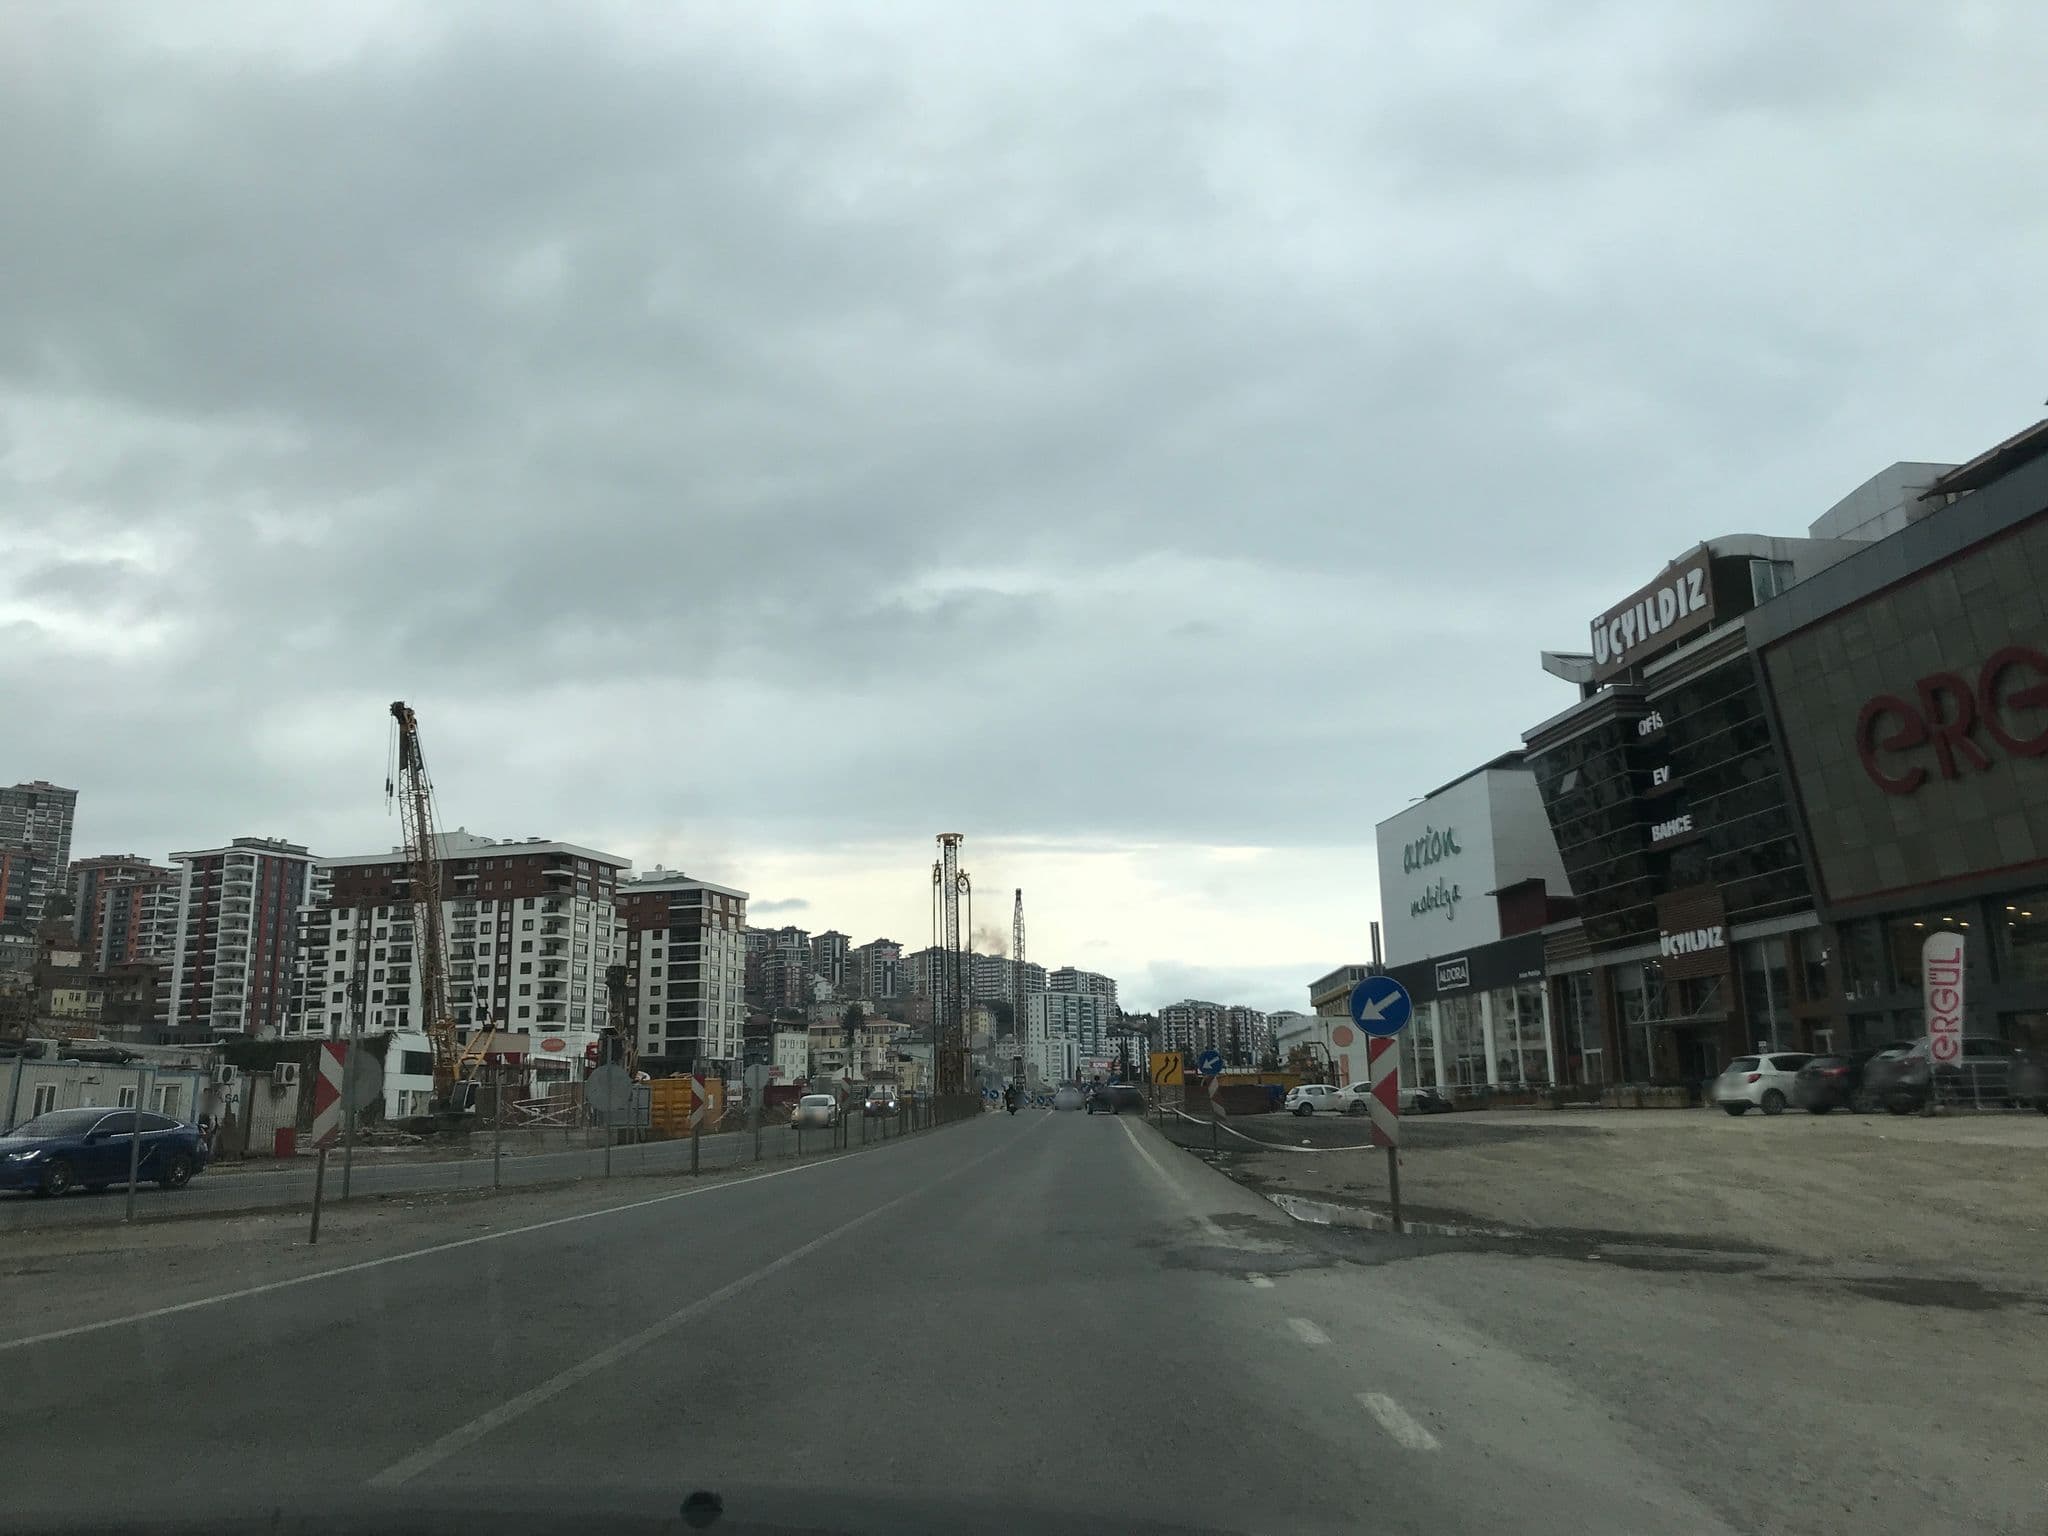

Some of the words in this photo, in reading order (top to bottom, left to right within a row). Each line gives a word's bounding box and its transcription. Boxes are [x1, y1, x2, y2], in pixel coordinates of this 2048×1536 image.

[1593, 567, 1707, 665] ÜÇYILDIZ
[1653, 765, 1670, 786] EV
[1660, 926, 1724, 960] ÜÇYILDIZ
